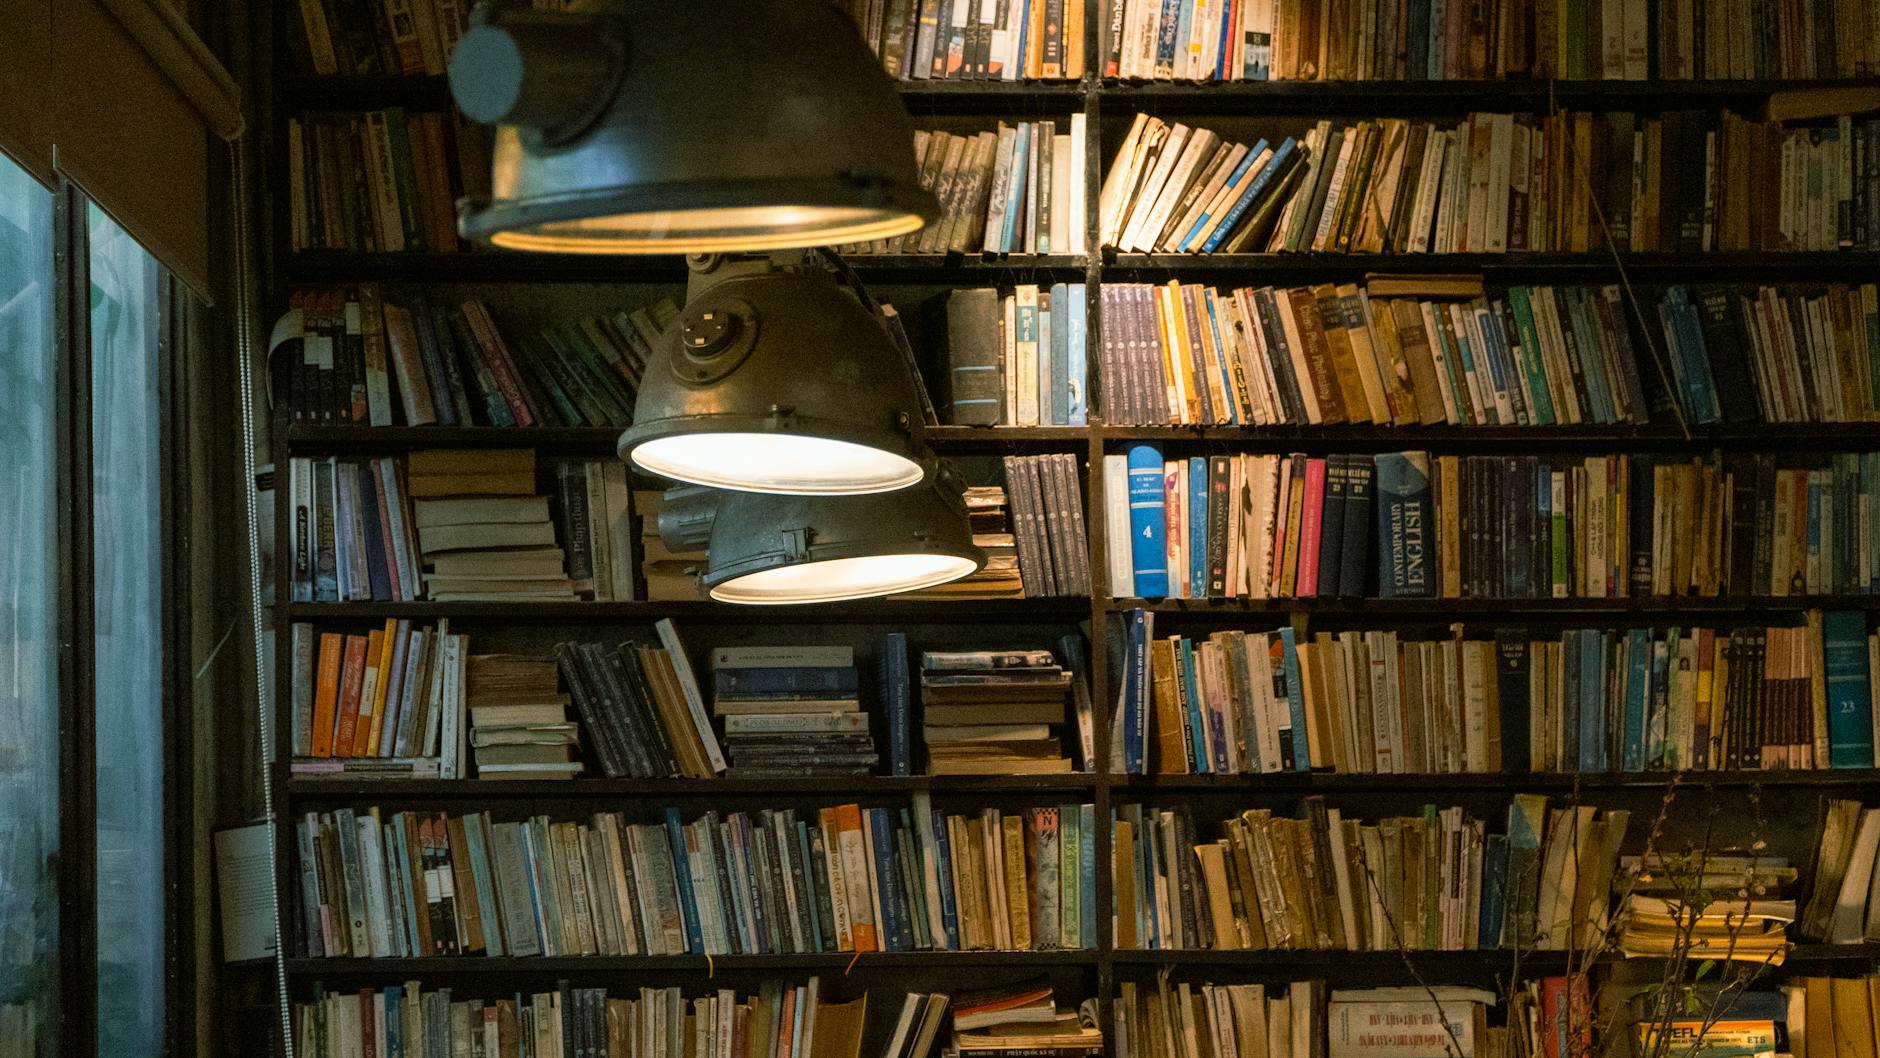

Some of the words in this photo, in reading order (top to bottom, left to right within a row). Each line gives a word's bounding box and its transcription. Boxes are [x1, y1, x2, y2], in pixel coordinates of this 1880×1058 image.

[1143, 525, 1152, 538] 4
[1391, 502, 1404, 586] CONTEMPORARY
[1404, 499, 1424, 585] ENGLISH
[1840, 701, 1855, 713] 23
[1747, 1036, 1766, 1044] ETS
